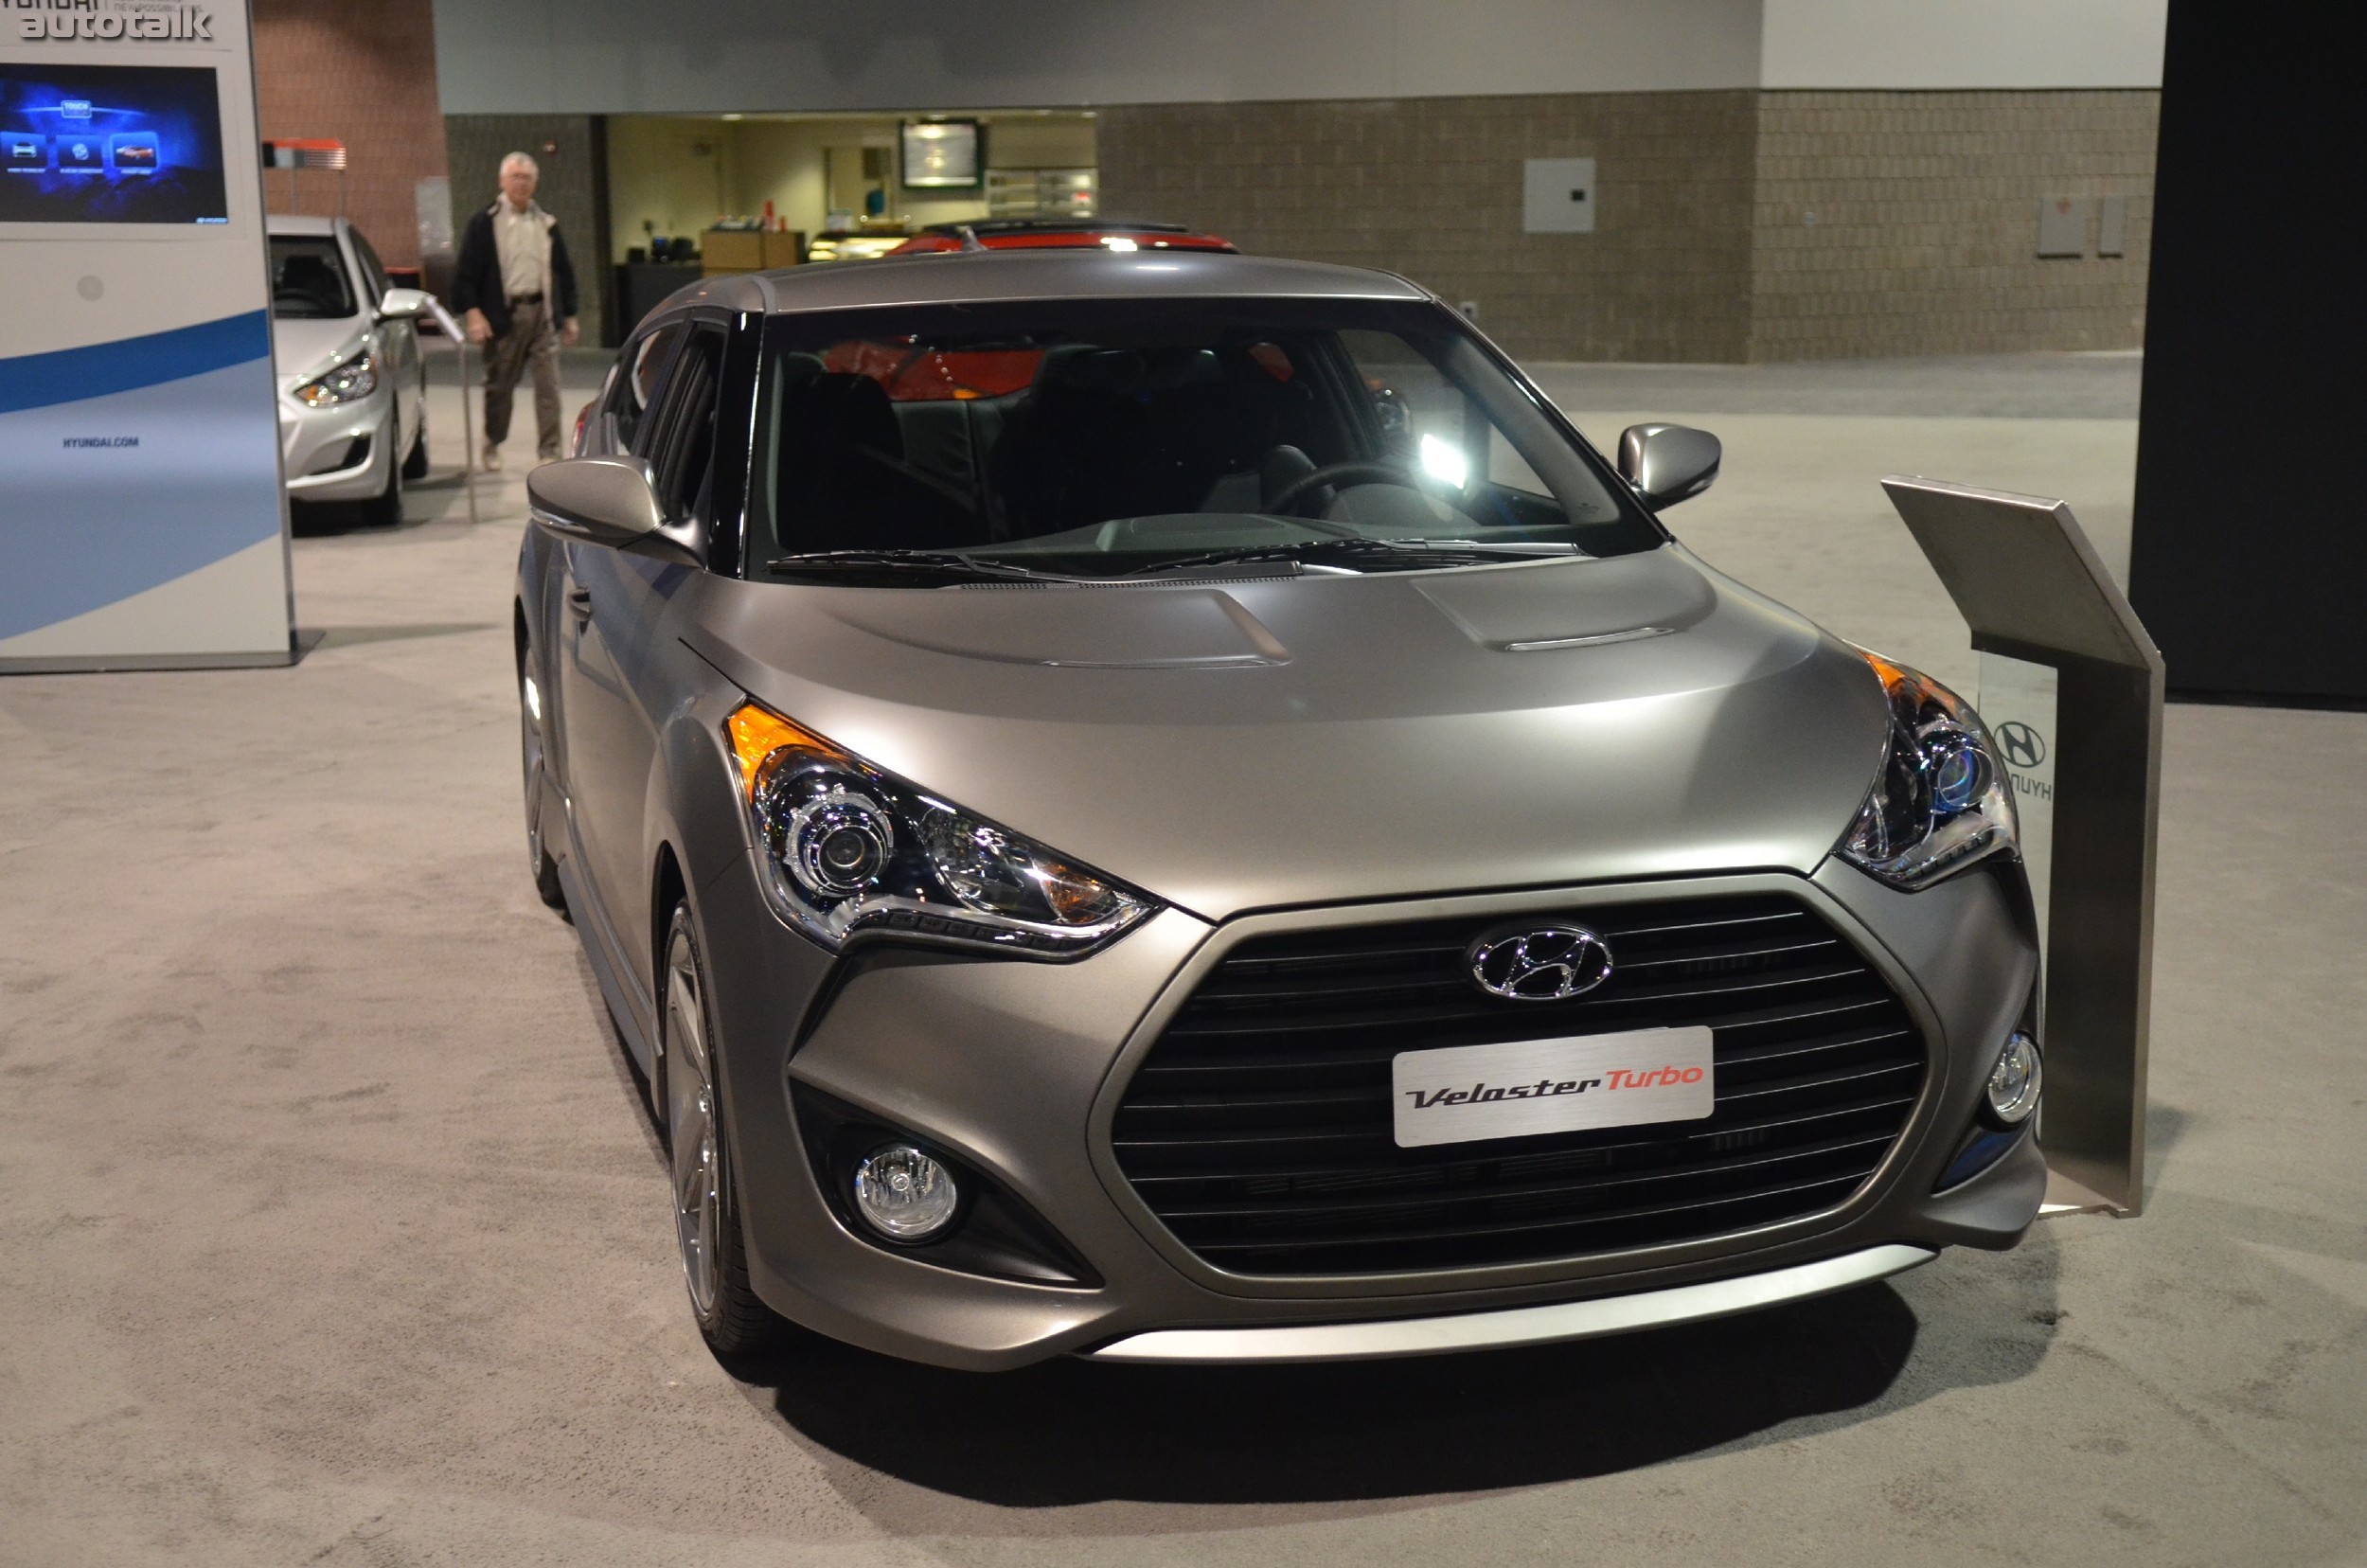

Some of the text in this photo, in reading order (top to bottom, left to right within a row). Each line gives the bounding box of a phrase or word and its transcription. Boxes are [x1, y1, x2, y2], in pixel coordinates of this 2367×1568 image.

[0, 0, 99, 11] YUNDAI
[62, 437, 139, 448] HYUNDAI.COM
[1405, 1065, 1703, 1109] Veloster Turbo
